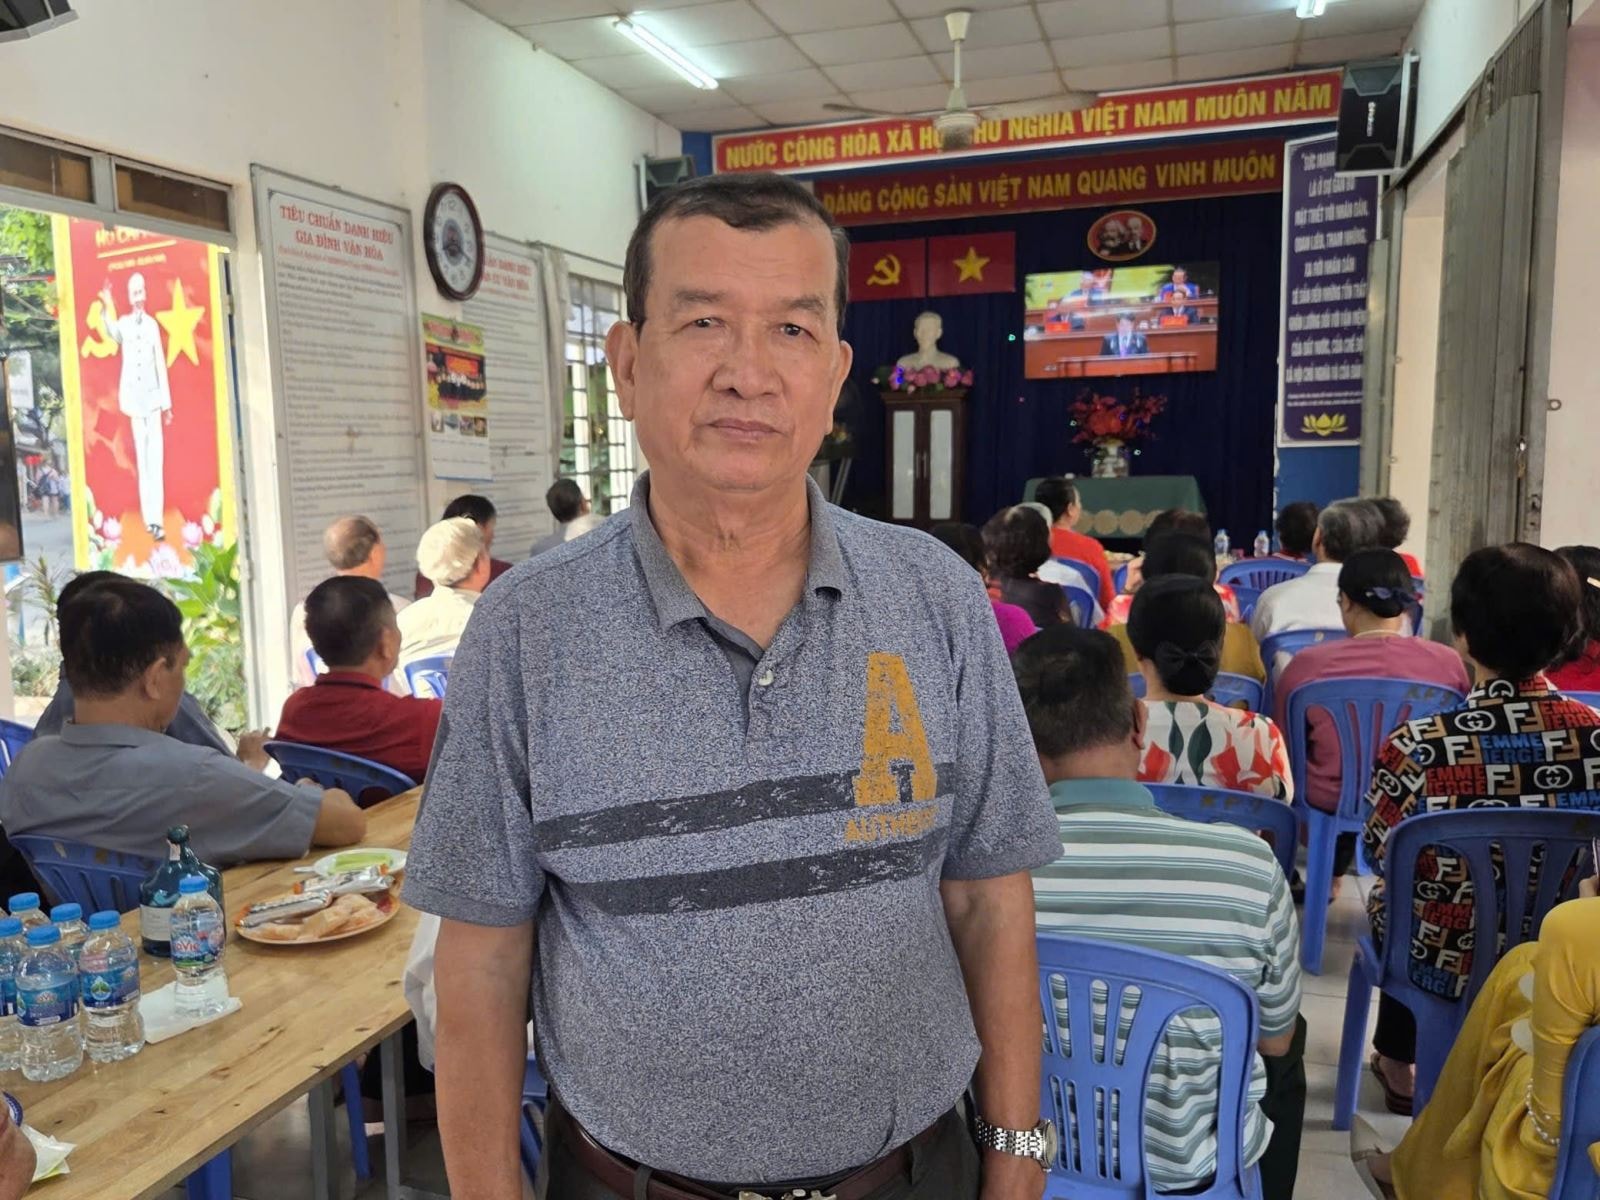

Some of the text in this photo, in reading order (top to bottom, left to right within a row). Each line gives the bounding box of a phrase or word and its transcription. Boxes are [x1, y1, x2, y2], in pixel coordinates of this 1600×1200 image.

[726, 140, 777, 169] NƯỚC
[782, 135, 836, 166] CỘNG
[841, 128, 881, 158] HÒA
[887, 124, 913, 153] XÃ
[1081, 101, 1128, 135] VIỆT
[1134, 98, 1188, 128] NAM
[1195, 87, 1266, 121] MUÔN
[1274, 82, 1331, 114] NĂM
[877, 184, 929, 215] CỘNG
[934, 175, 972, 206] SẢN
[979, 173, 1021, 207] VIỆT
[1027, 172, 1071, 199] NAM
[1077, 166, 1146, 196] QUANG
[1156, 160, 1206, 189] VINH
[1213, 151, 1275, 184] MUÔN
[280, 203, 305, 223] TIÊU
[344, 221, 370, 239] DANH
[296, 229, 313, 245] GIA
[316, 232, 341, 252] ĐÌNH
[343, 239, 363, 256] VĂN
[364, 243, 384, 261] HÓA
[852, 651, 938, 806] A
